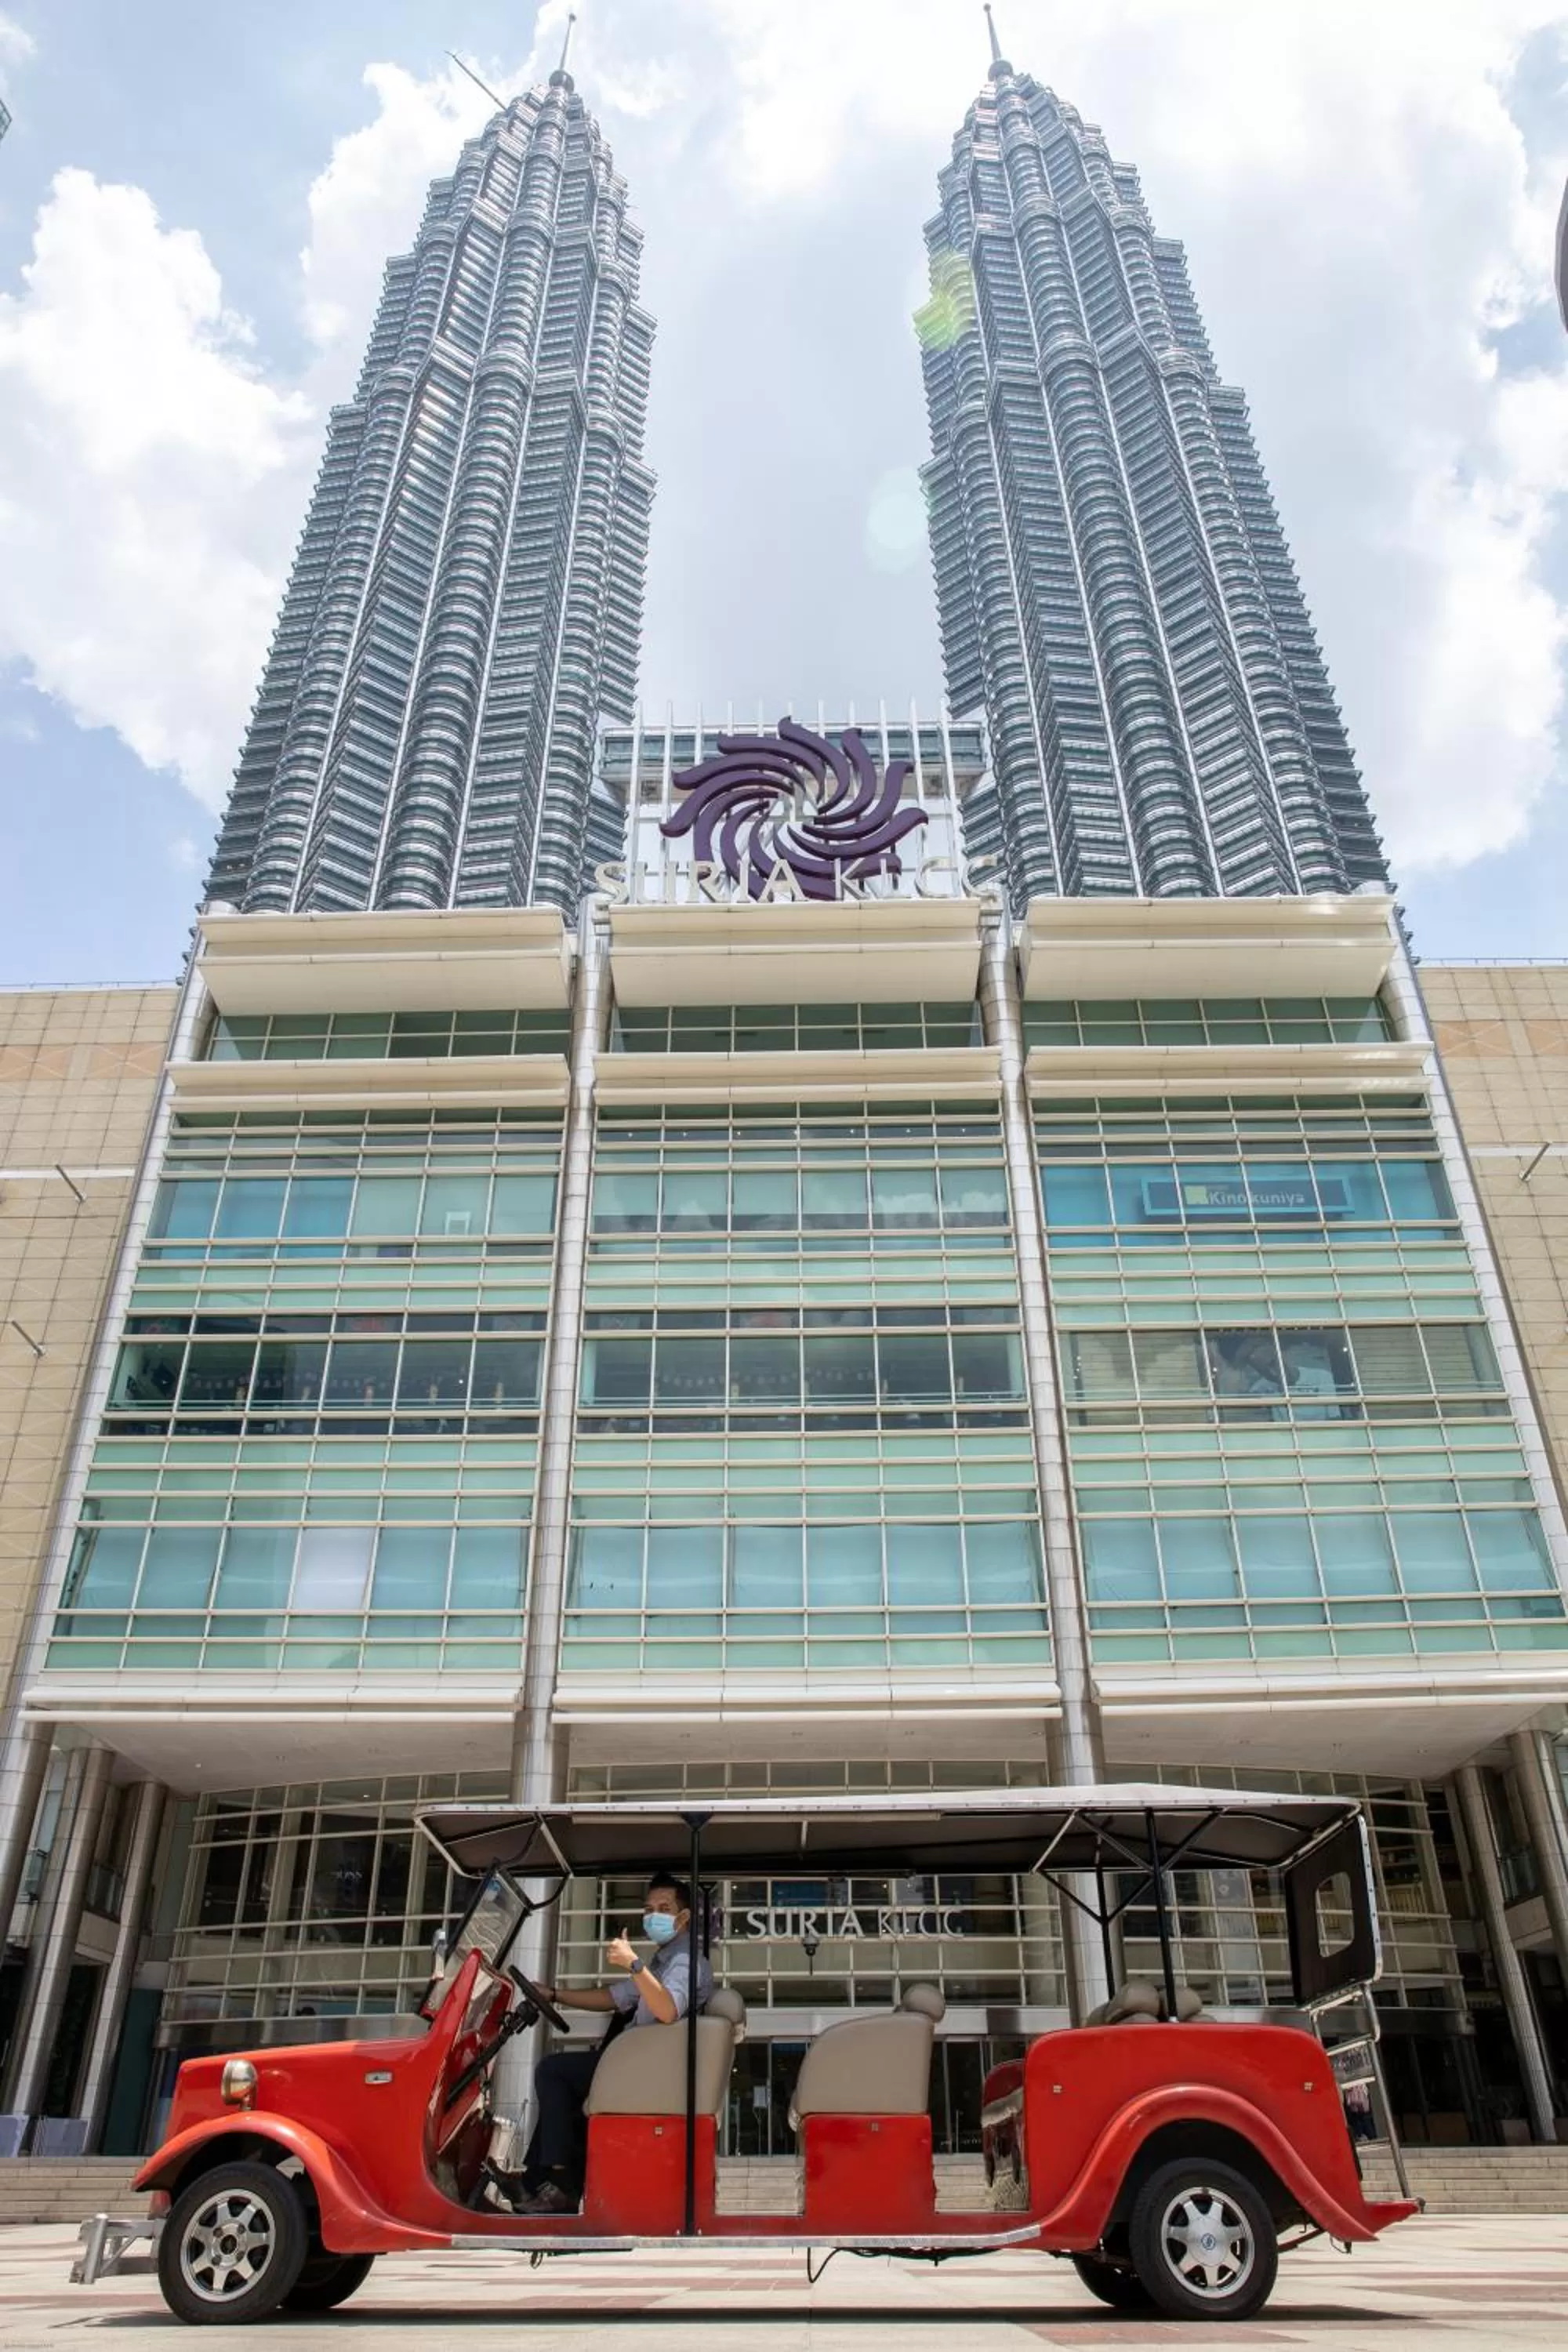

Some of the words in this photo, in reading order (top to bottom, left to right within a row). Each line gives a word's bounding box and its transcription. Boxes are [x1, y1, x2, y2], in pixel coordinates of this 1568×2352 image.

[594, 858, 809, 904] SURIA
[833, 855, 999, 901] KLCC
[1209, 1191, 1305, 1207] Kinokuniya
[746, 1908, 865, 1939] SURIA
[877, 1907, 965, 1939] KLCC
